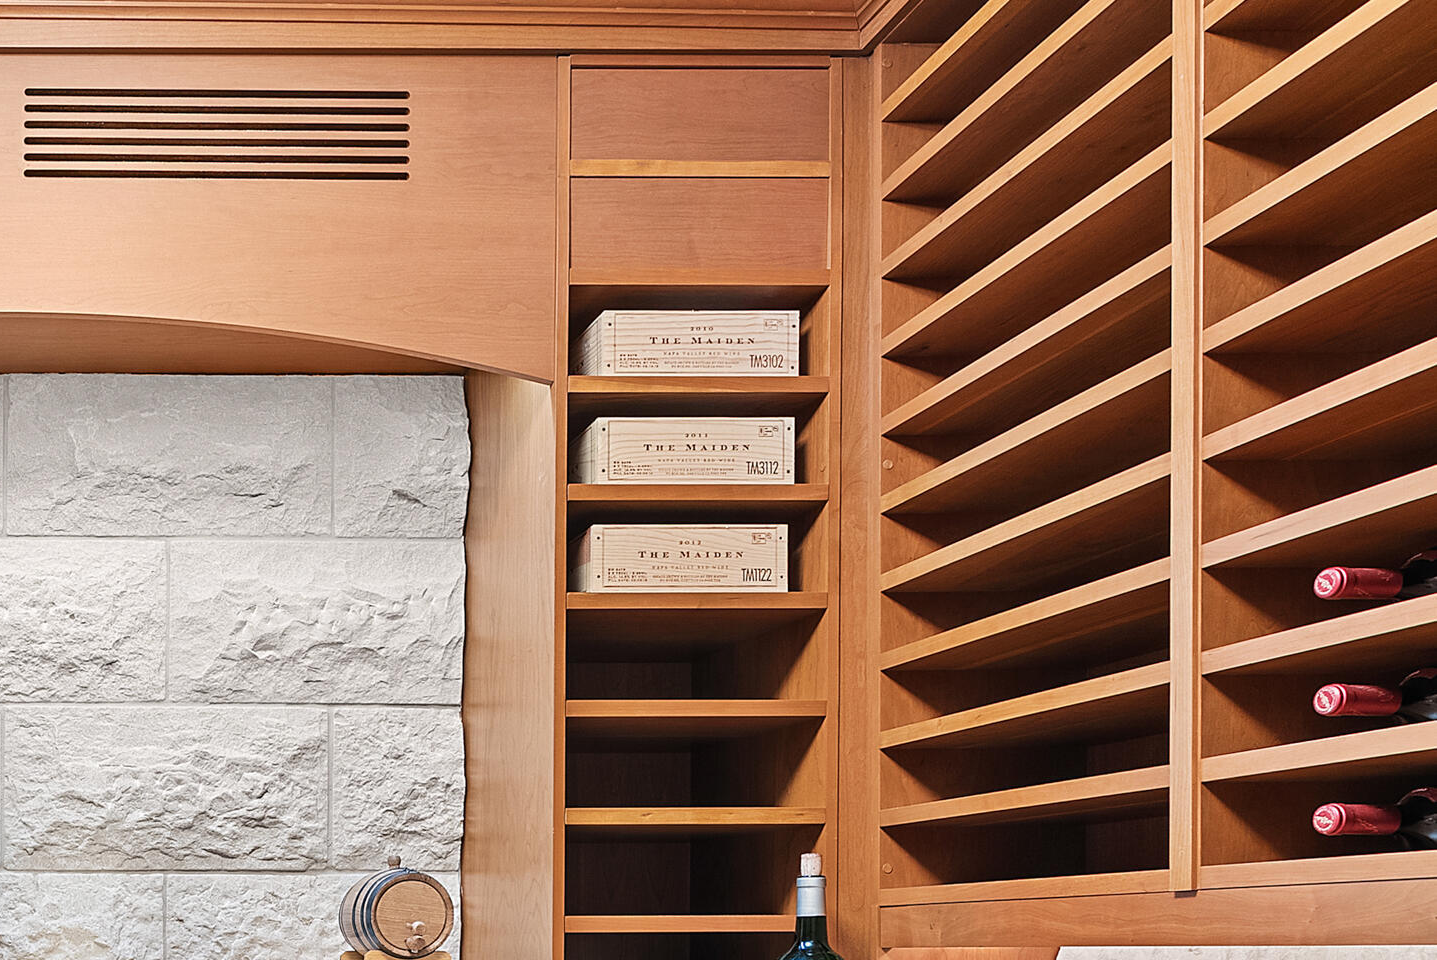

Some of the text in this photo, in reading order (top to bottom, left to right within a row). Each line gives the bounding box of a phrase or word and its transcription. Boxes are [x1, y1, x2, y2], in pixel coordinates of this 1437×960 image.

[649, 336, 756, 345] THE MAIDEN
[749, 354, 784, 369] TM3102
[746, 460, 779, 475] TM3112
[741, 568, 772, 582] TM1122
